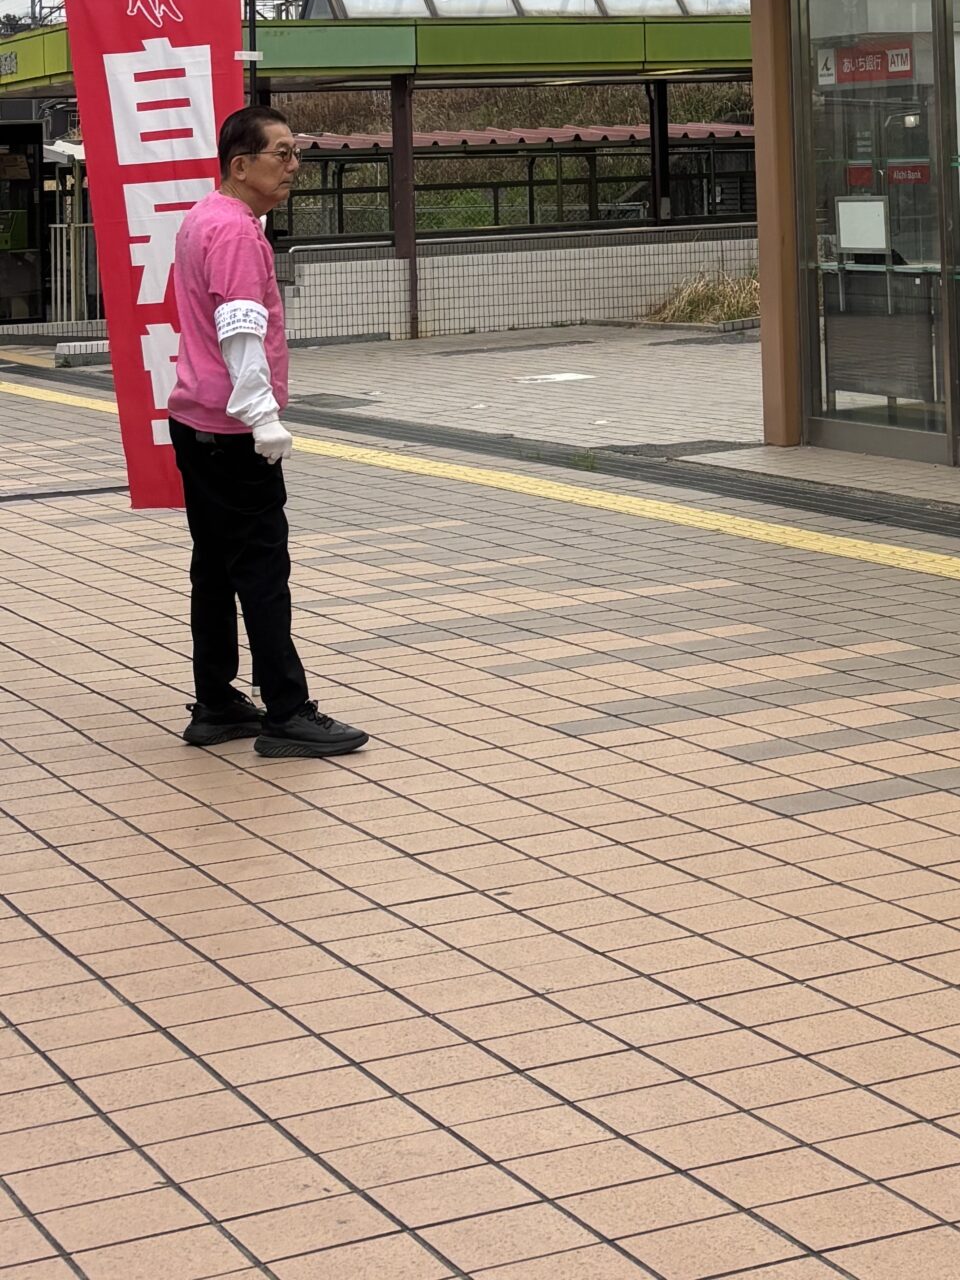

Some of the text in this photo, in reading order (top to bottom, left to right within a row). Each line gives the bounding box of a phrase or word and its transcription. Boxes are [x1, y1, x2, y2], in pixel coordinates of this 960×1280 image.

[842, 52, 909, 73] あいち銀行 ATM
